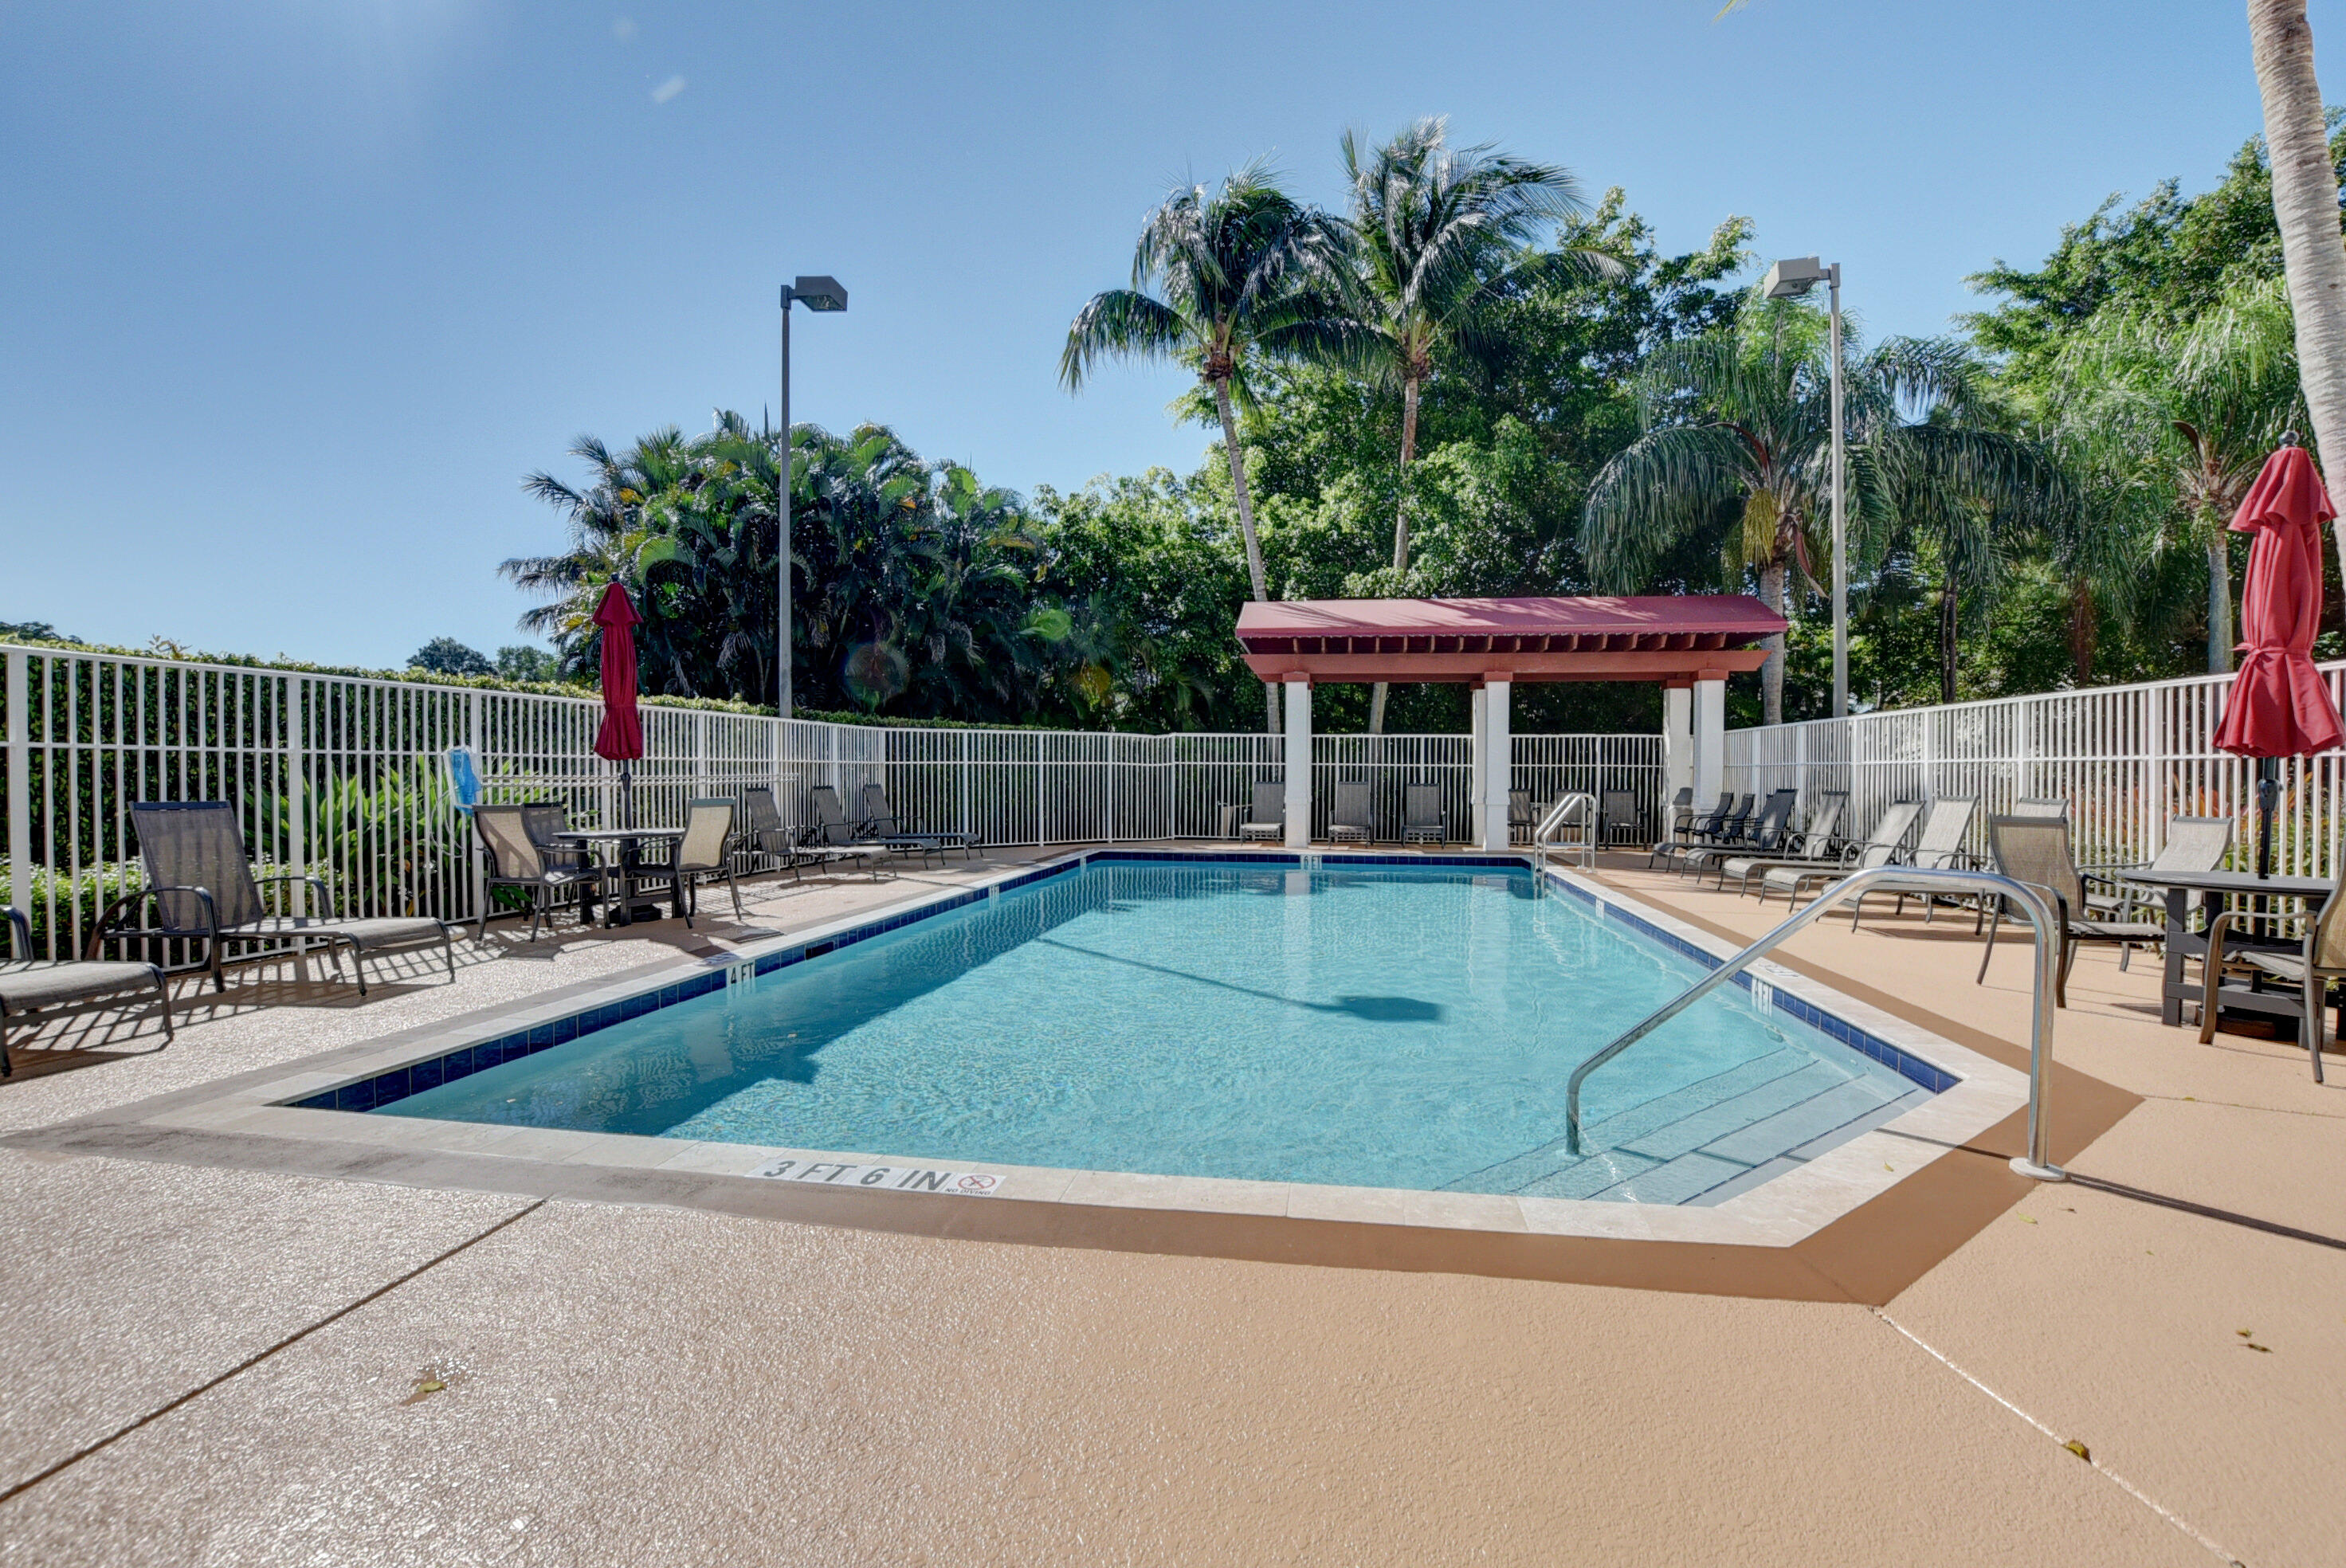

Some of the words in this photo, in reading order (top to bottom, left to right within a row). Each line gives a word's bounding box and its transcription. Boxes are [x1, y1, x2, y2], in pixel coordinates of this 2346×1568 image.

[731, 966, 737, 984] 4
[741, 962, 754, 982] FT
[1762, 981, 1771, 1002] FT
[763, 1161, 796, 1177] 3
[797, 1163, 857, 1182] FT
[861, 1168, 890, 1185] 6
[897, 1170, 951, 1190] IN
